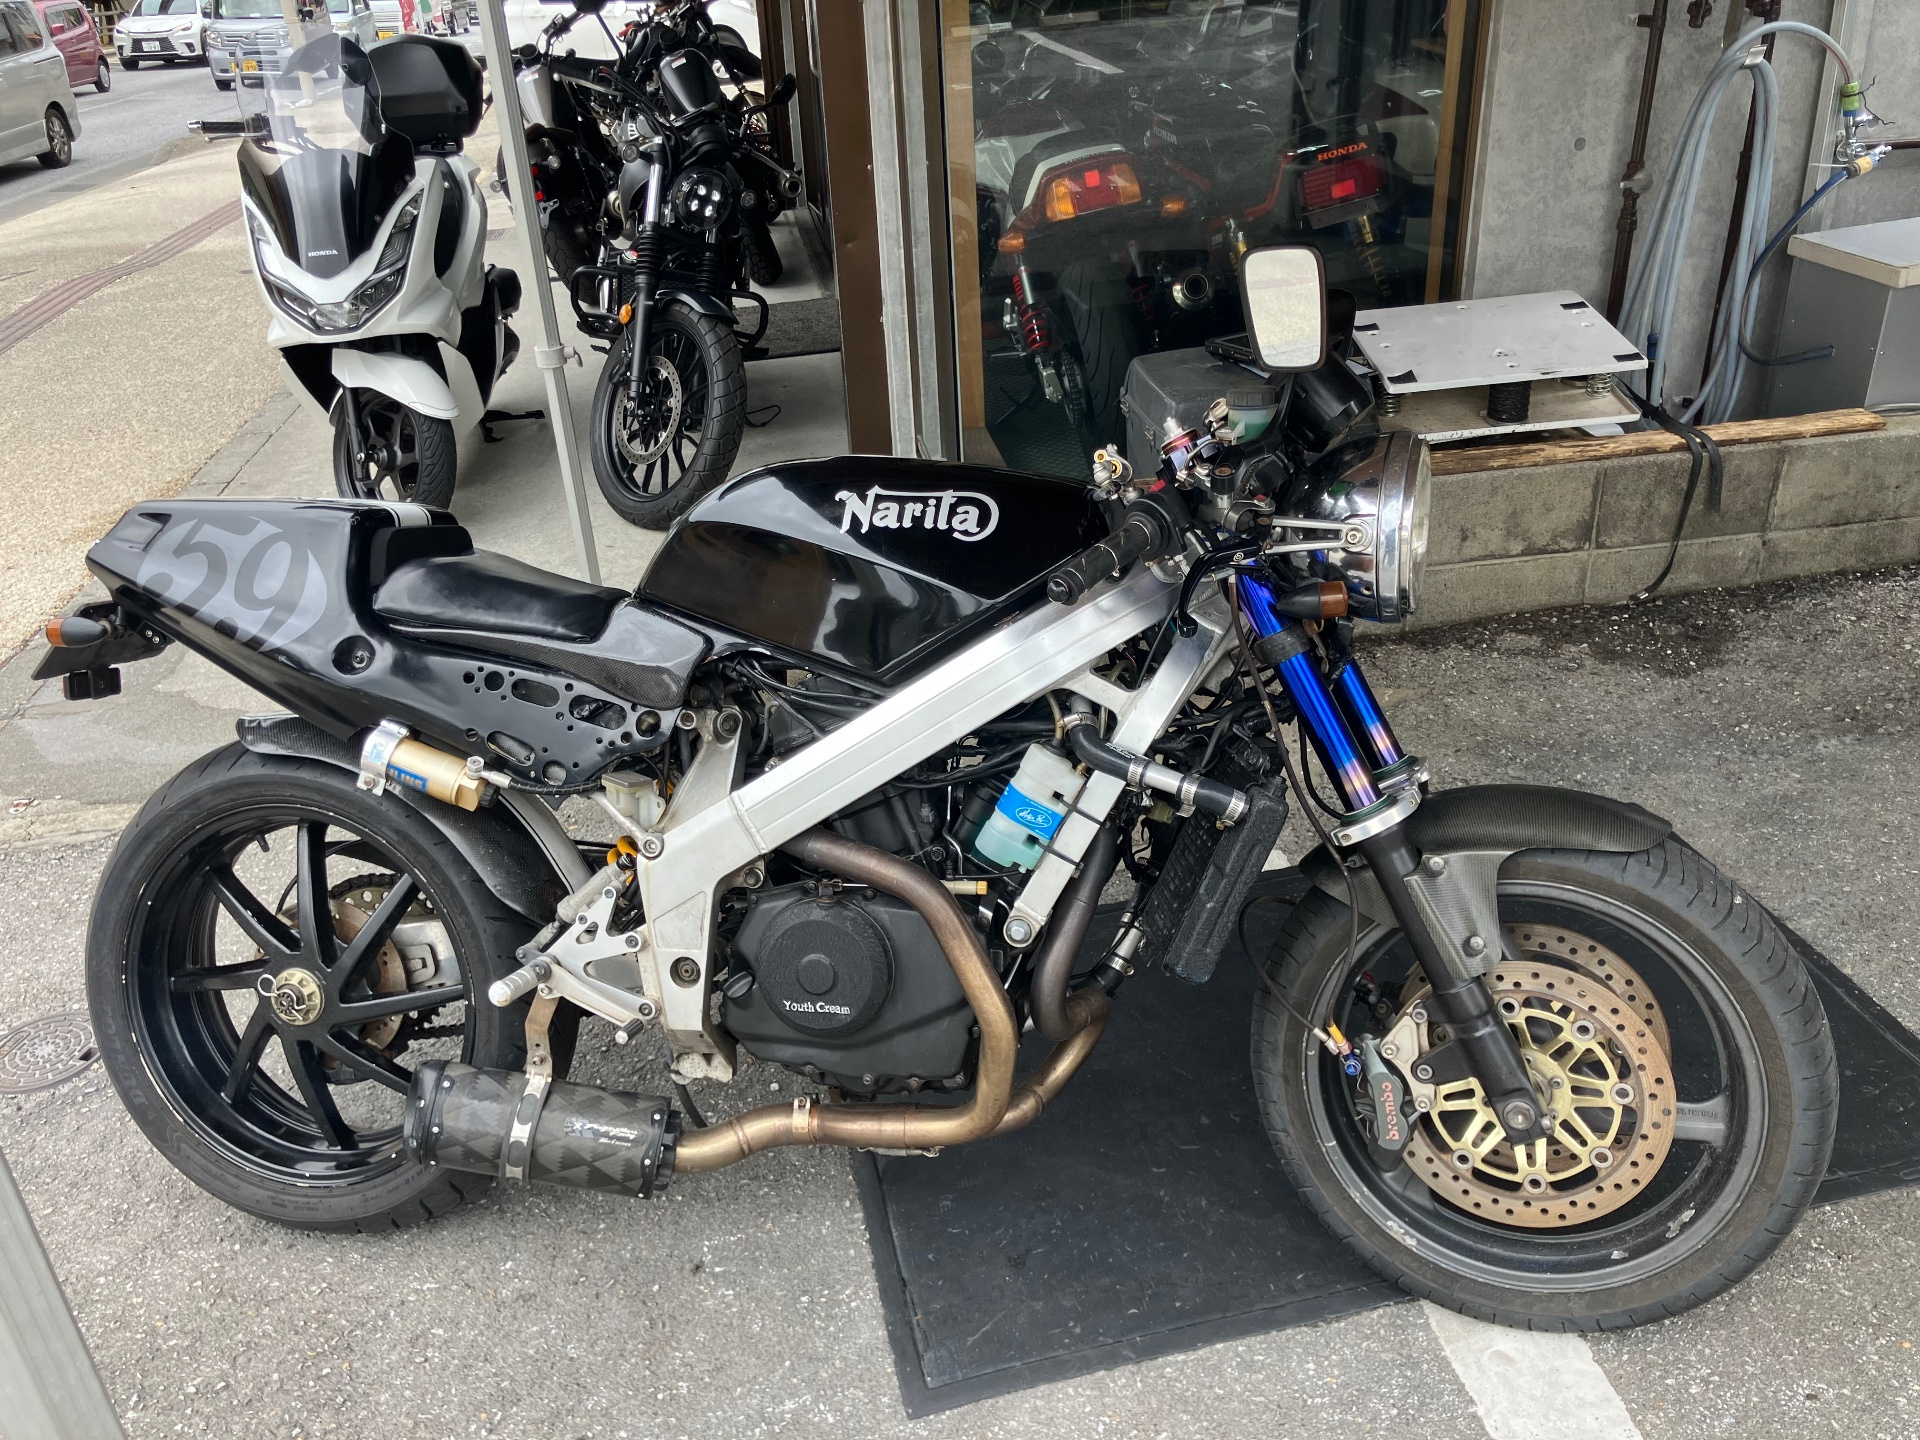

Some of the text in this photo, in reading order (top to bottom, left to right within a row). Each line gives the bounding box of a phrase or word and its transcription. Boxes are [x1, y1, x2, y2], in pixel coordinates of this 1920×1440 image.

[1316, 142, 1368, 161] HONDA
[835, 485, 999, 542] Narita
[143, 516, 310, 644] 59
[783, 1000, 851, 1015] Youth Cream
[1381, 1082, 1400, 1140] brembo
